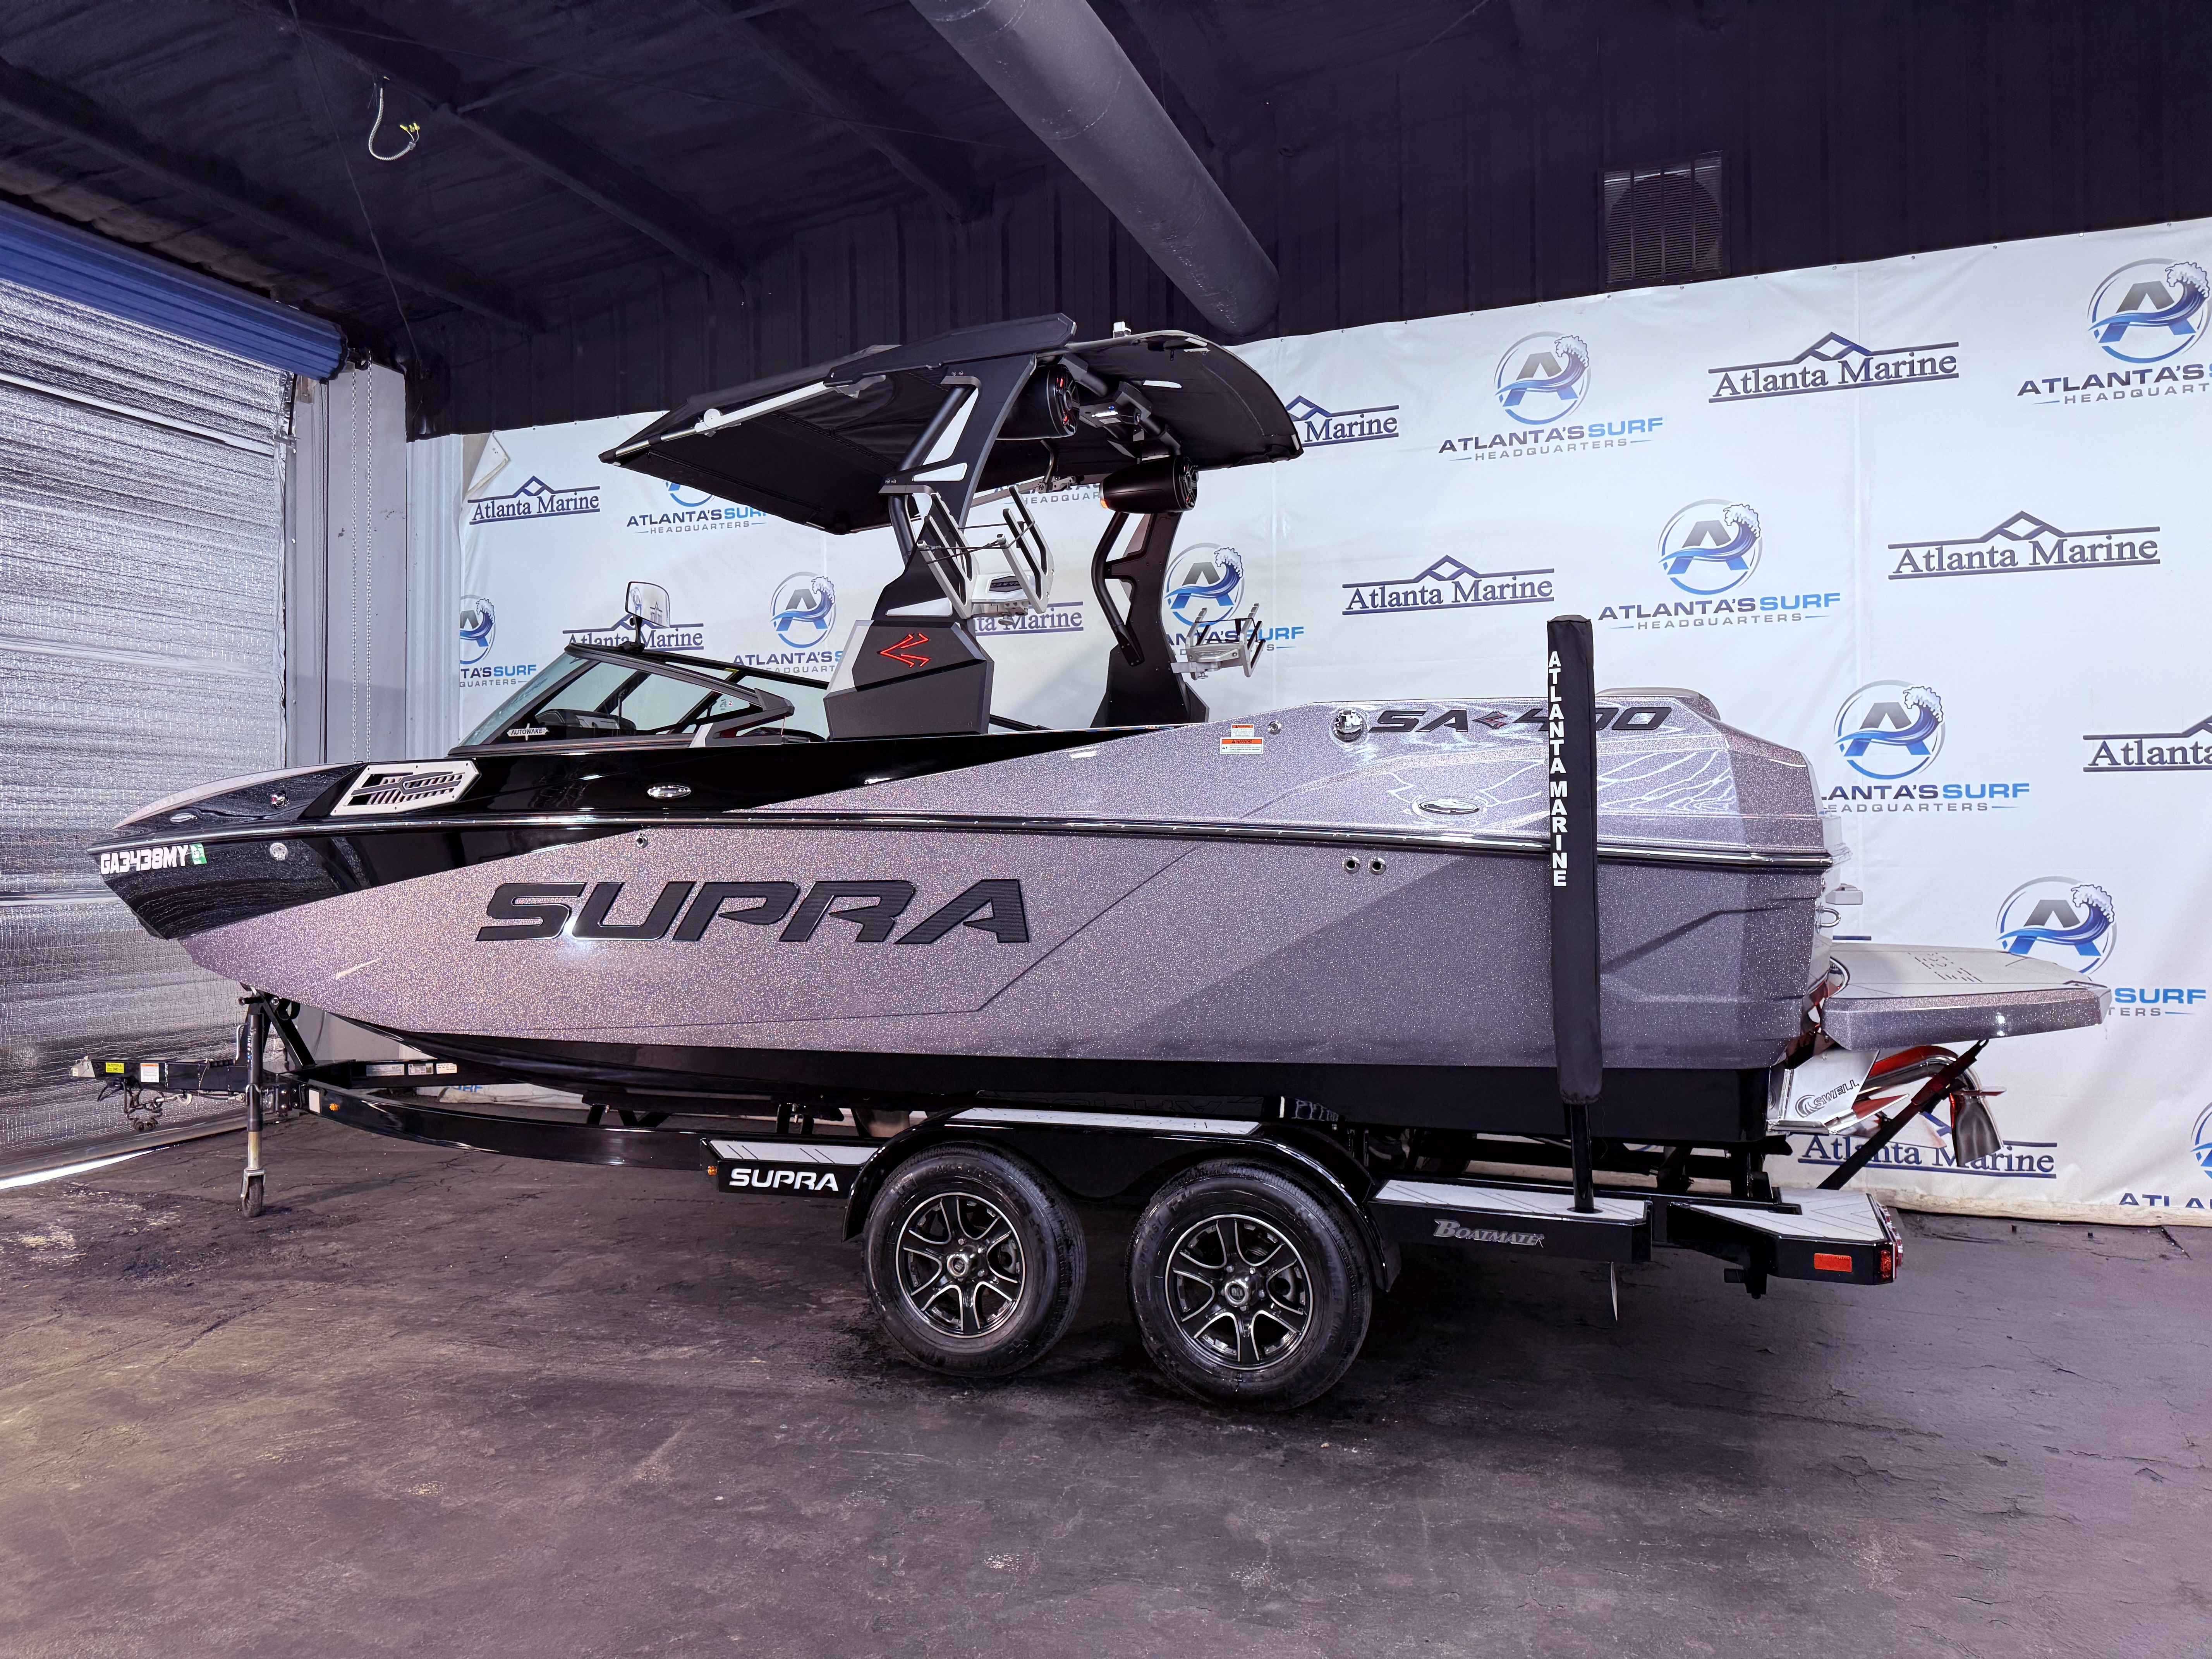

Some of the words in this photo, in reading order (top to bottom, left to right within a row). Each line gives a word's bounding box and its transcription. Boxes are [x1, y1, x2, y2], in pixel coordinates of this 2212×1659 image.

[1712, 366, 1829, 397] Atlanta
[1838, 352, 1957, 384] Marine
[2017, 364, 2204, 396] ATLANTA'S
[1304, 414, 1397, 442] Marine
[1475, 438, 1627, 461] HEADQUARTERS
[472, 500, 532, 520] Atlanta
[537, 492, 599, 514] Marine
[650, 521, 749, 534] HEADQUARTERS
[1893, 545, 2018, 574] Atlanta
[2028, 535, 2158, 565] Marine
[1346, 585, 1444, 610] Atlanta
[1451, 576, 1553, 603] Marine
[1638, 613, 1802, 630] HEADQUARTERS
[641, 628, 703, 648] Marine
[1548, 651, 1566, 774] ATLANTA
[1549, 781, 1568, 886] MARINE
[476, 879, 1029, 945] SUPRA
[2114, 988, 2206, 1004] SURF
[1814, 1079, 1860, 1107] SWELL
[729, 1168, 839, 1192] SUPRA
